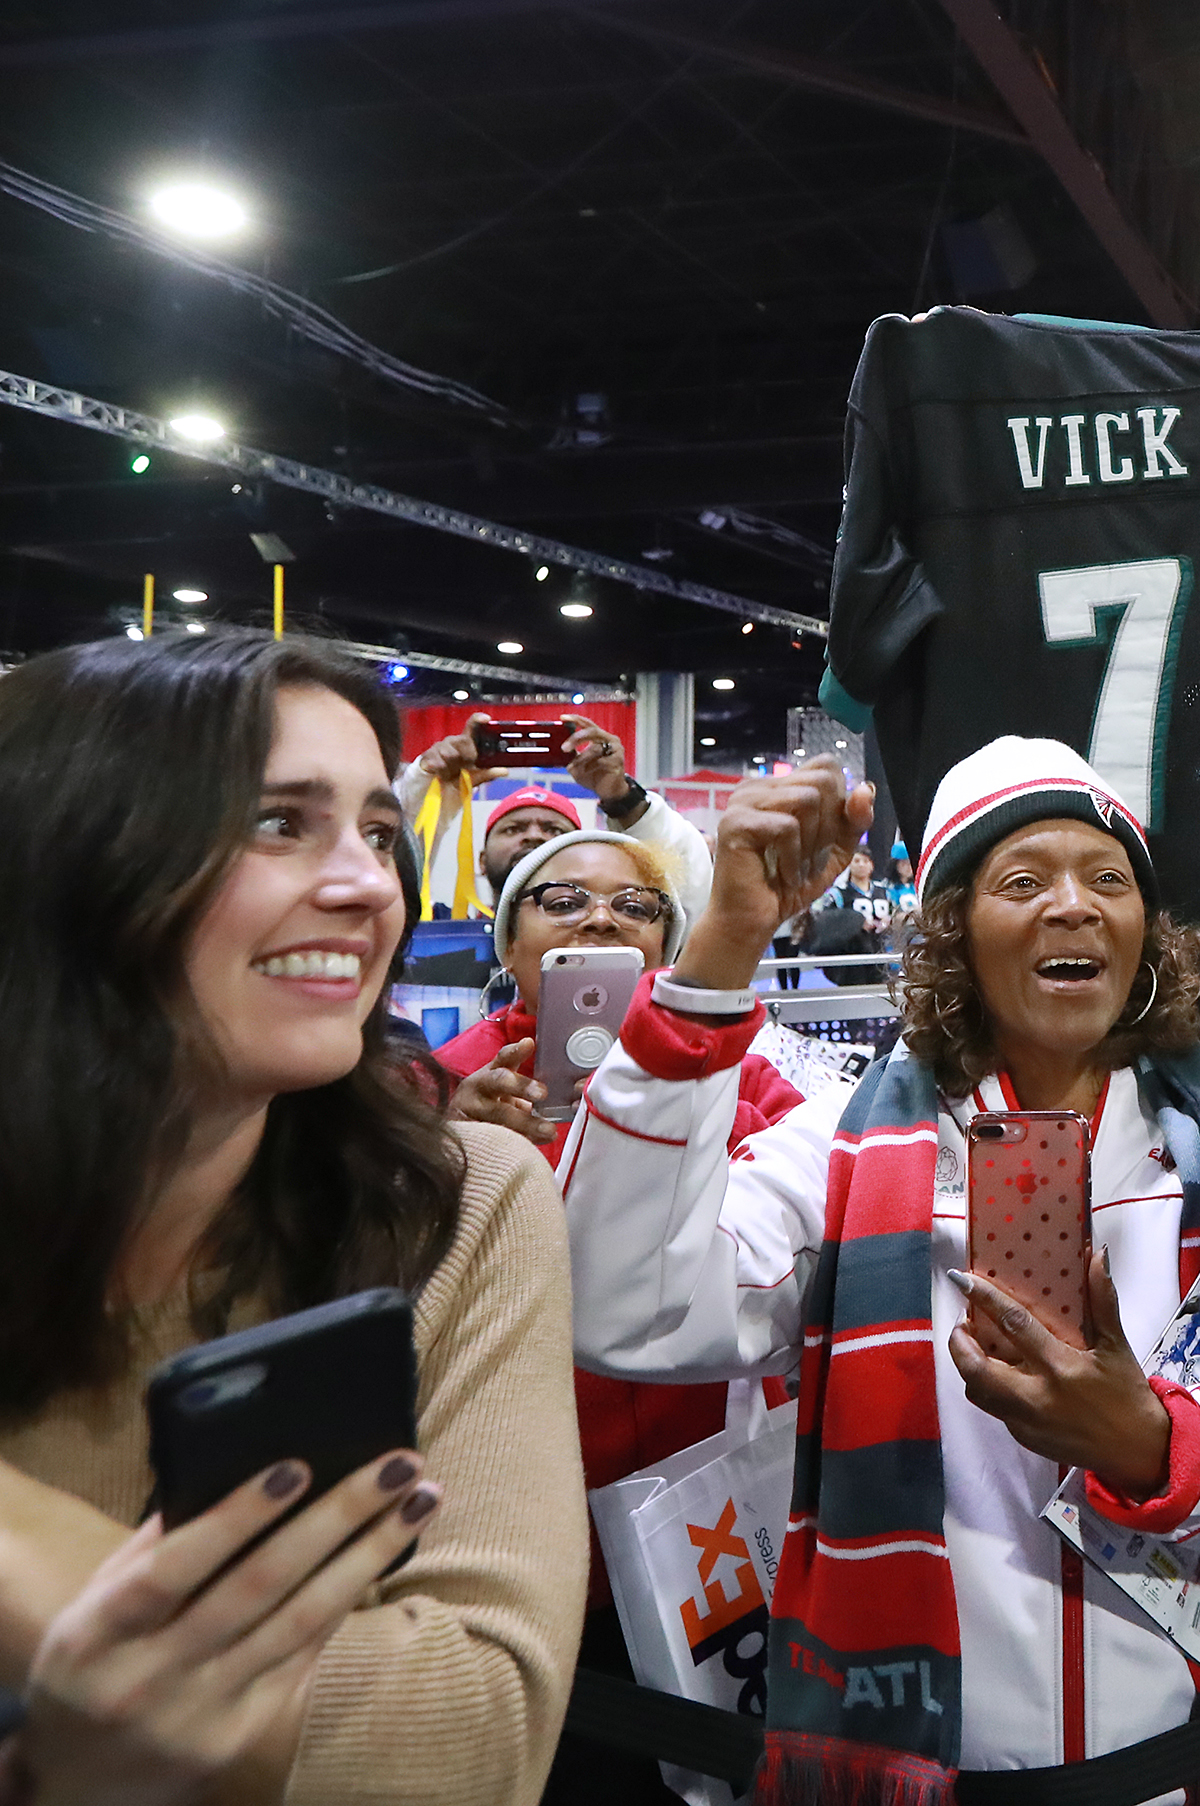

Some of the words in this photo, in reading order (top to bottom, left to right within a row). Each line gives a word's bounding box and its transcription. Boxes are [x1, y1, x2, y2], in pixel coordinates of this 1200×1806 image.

[1007, 406, 1189, 490] VICK
[1038, 556, 1193, 830] 7
[842, 1660, 945, 1716] ATL
